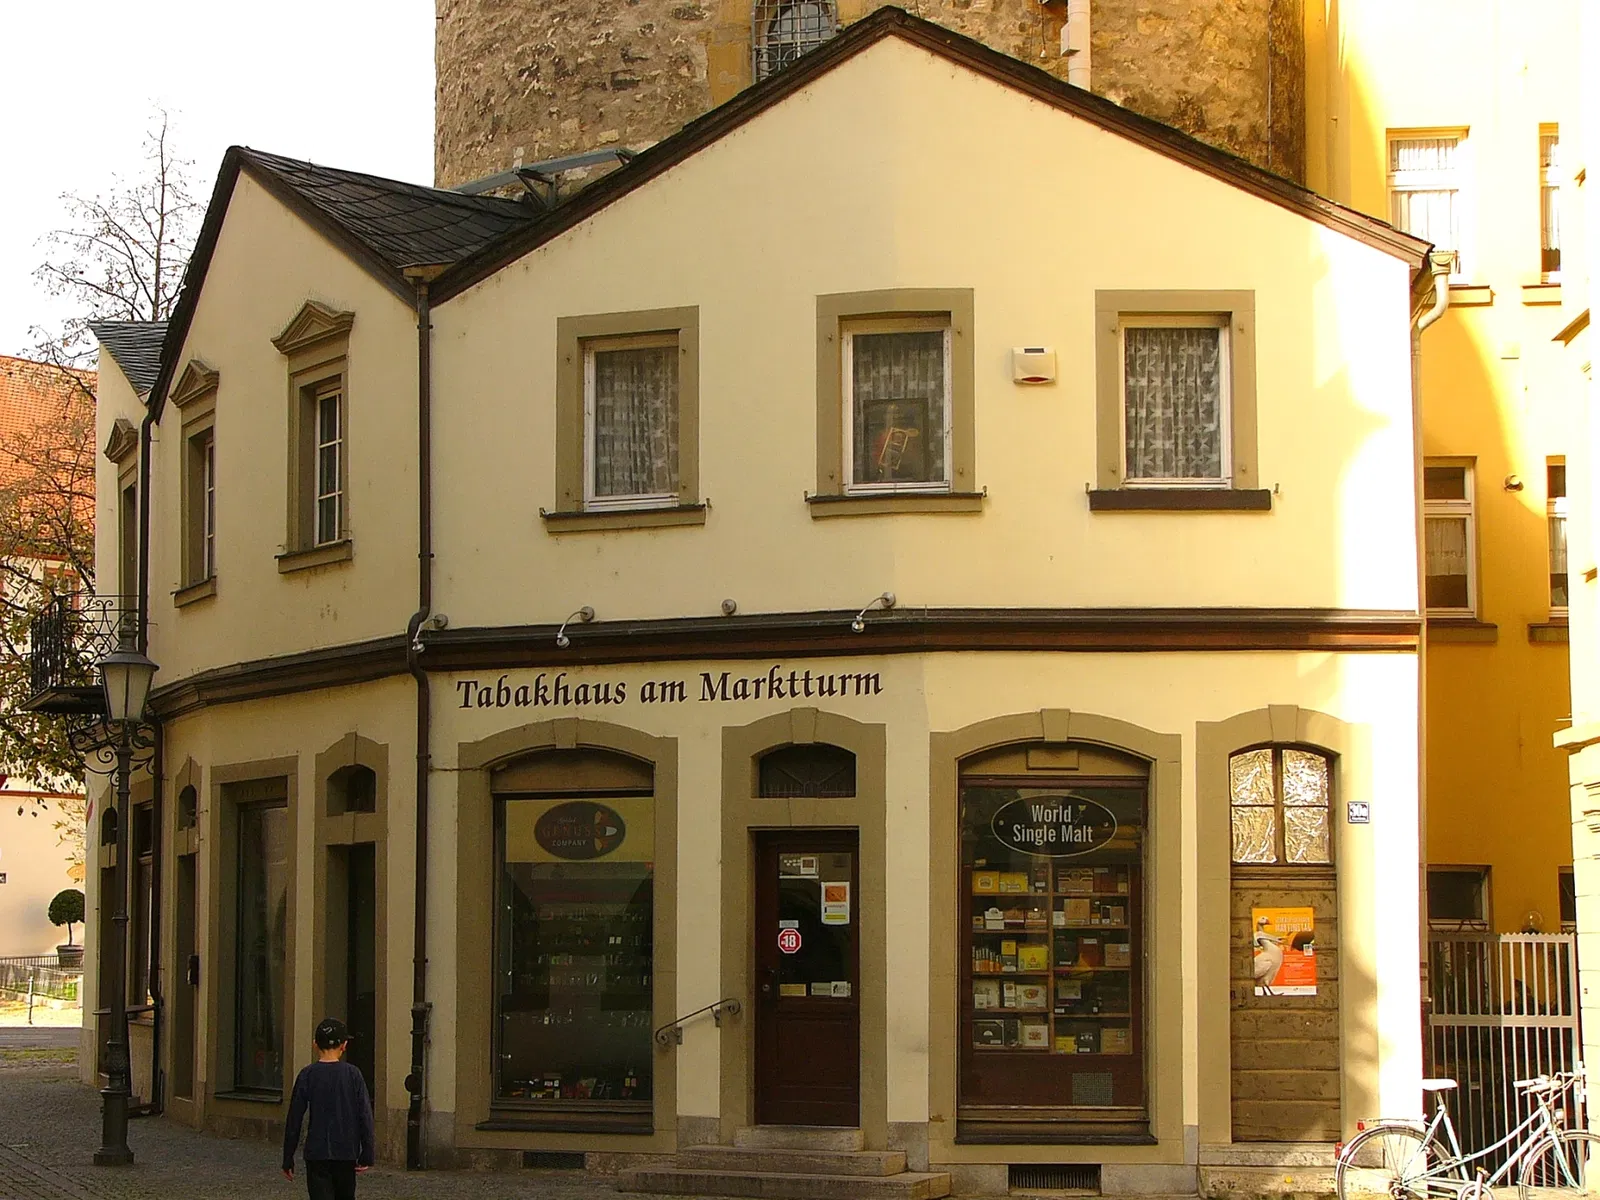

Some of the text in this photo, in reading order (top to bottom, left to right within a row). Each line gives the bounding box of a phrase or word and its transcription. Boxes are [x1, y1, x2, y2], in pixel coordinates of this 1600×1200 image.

[456, 664, 884, 709] Tabakhaus am Marktturm
[1032, 805, 1072, 823] World
[551, 838, 587, 847] COMPANY
[1013, 825, 1093, 846] Single Malt
